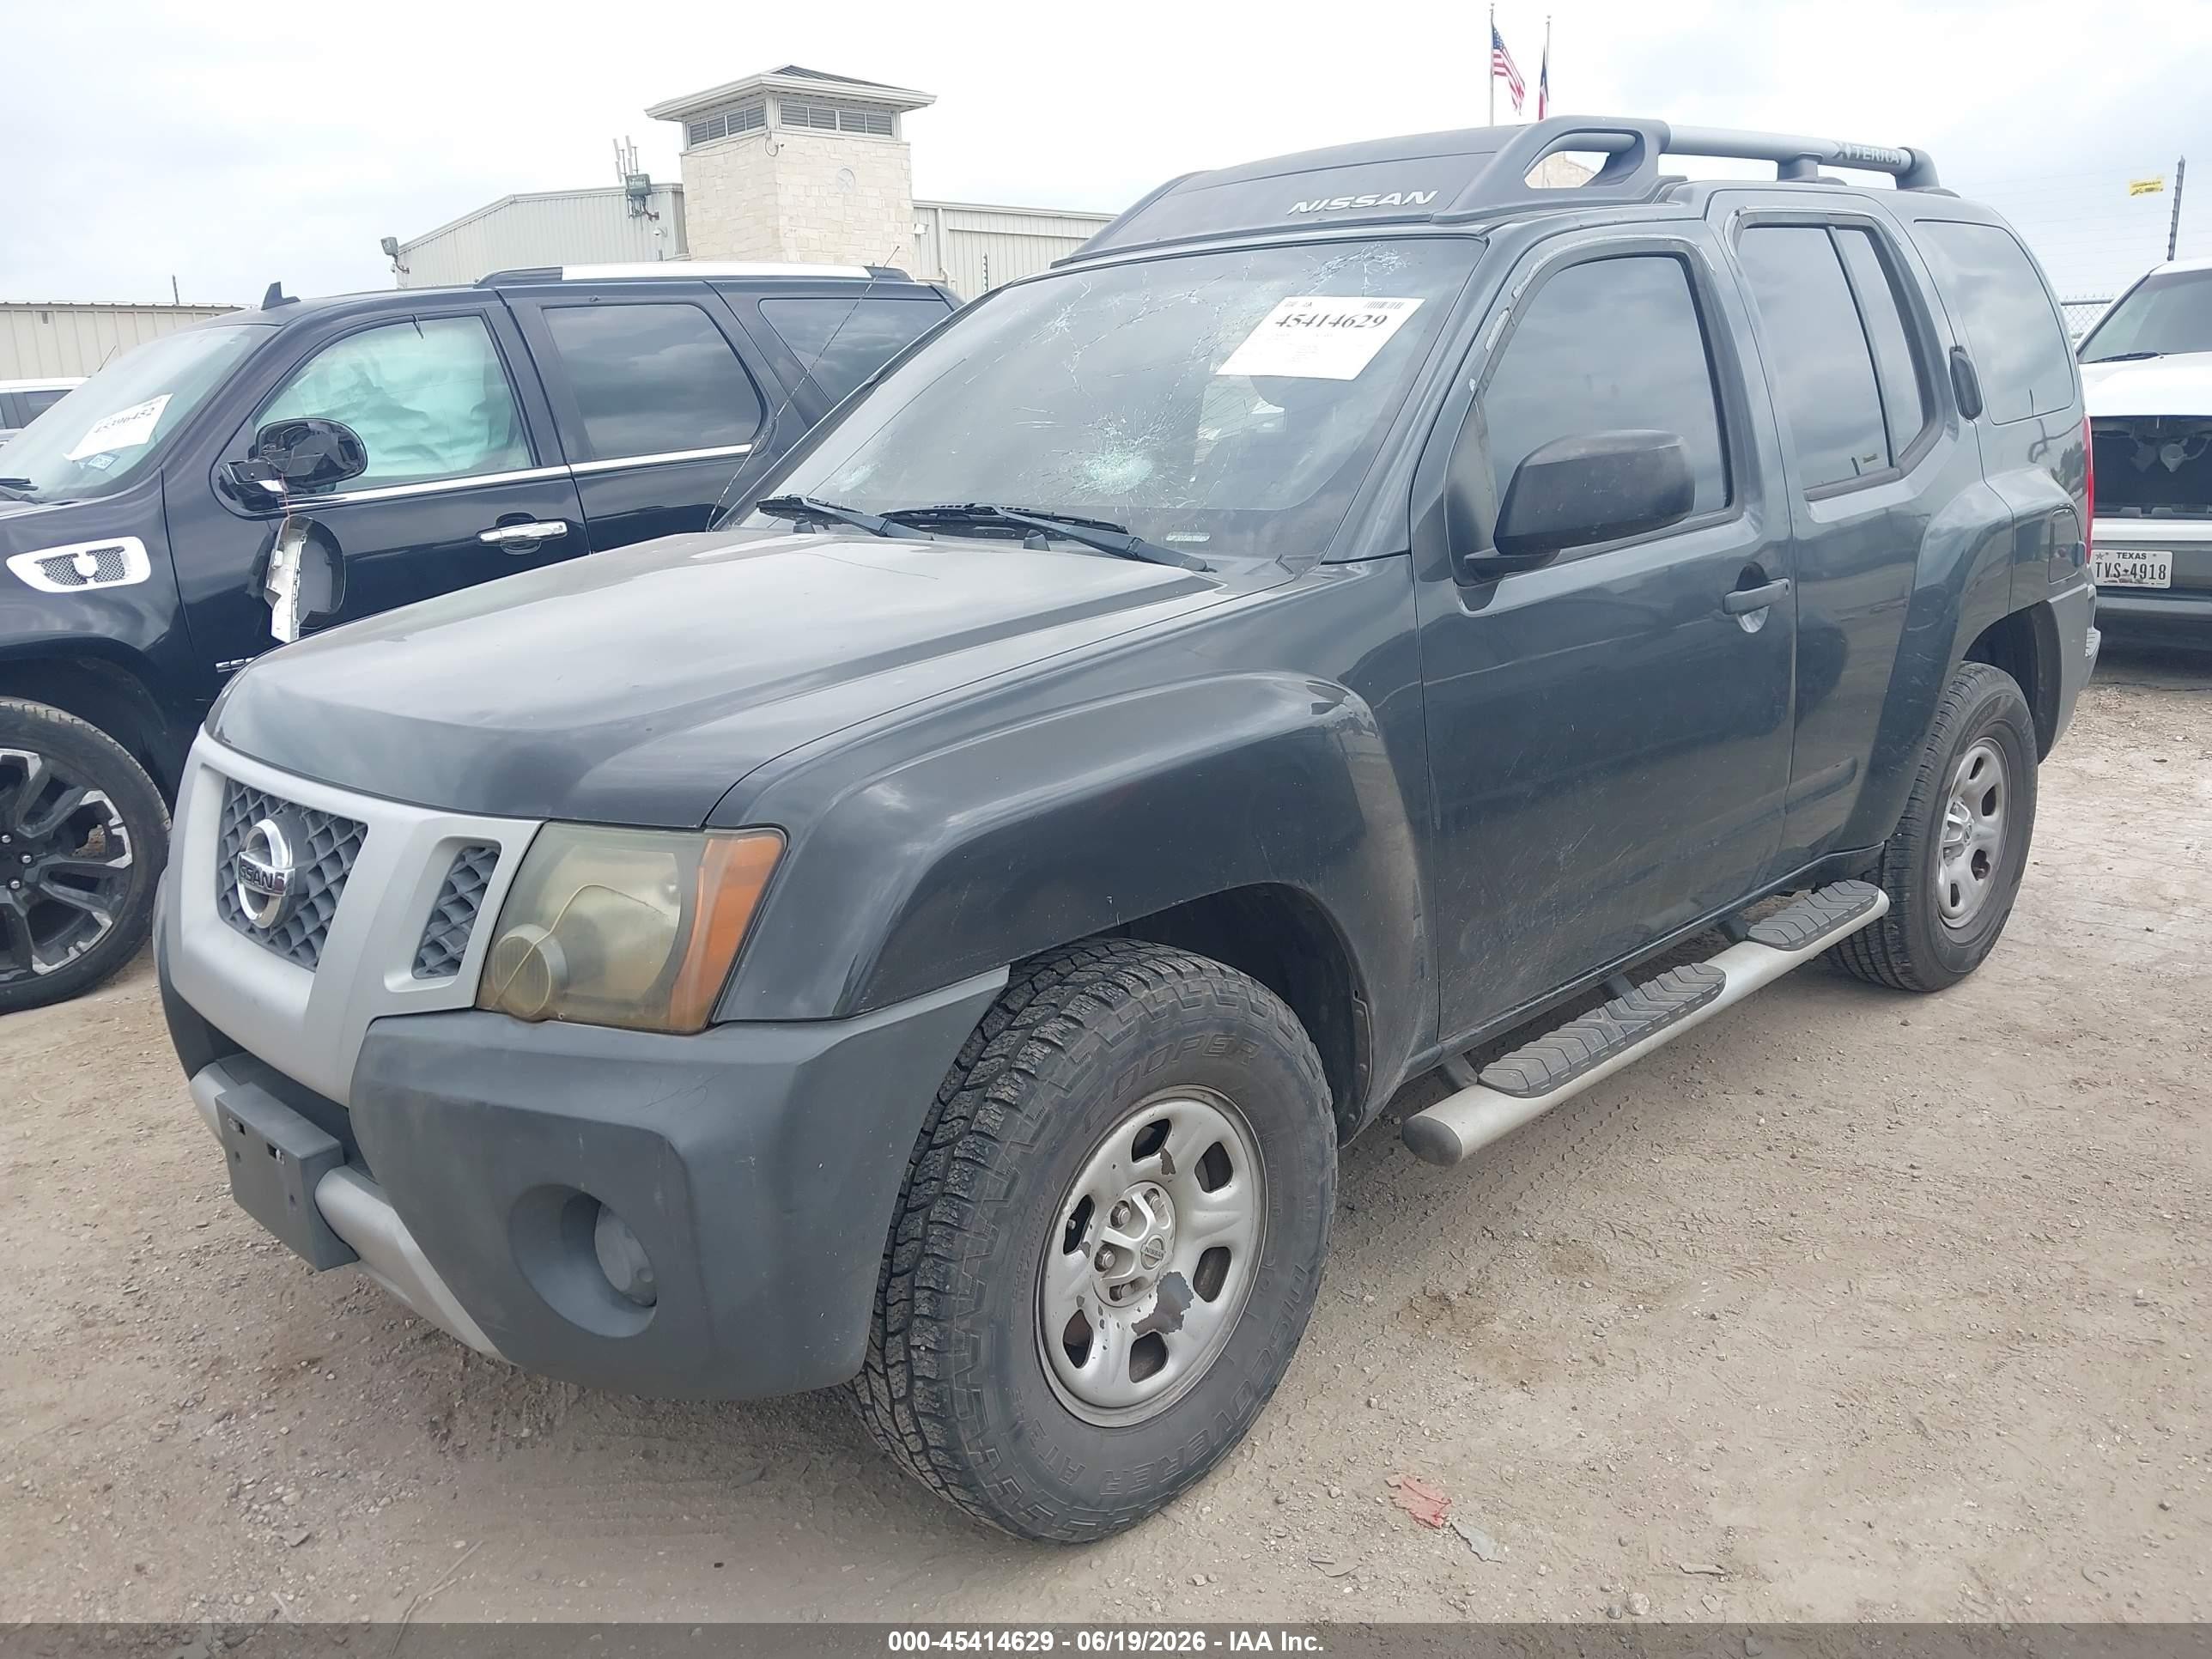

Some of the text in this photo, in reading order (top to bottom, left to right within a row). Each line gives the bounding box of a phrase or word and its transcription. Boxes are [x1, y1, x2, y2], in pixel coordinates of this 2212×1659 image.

[1832, 141, 1901, 165] XTERRA
[1287, 191, 1438, 216] NISSAN
[1275, 313, 1389, 328] 45414629
[2116, 551, 2147, 560] TEXAS
[2130, 562, 2166, 580] 4918
